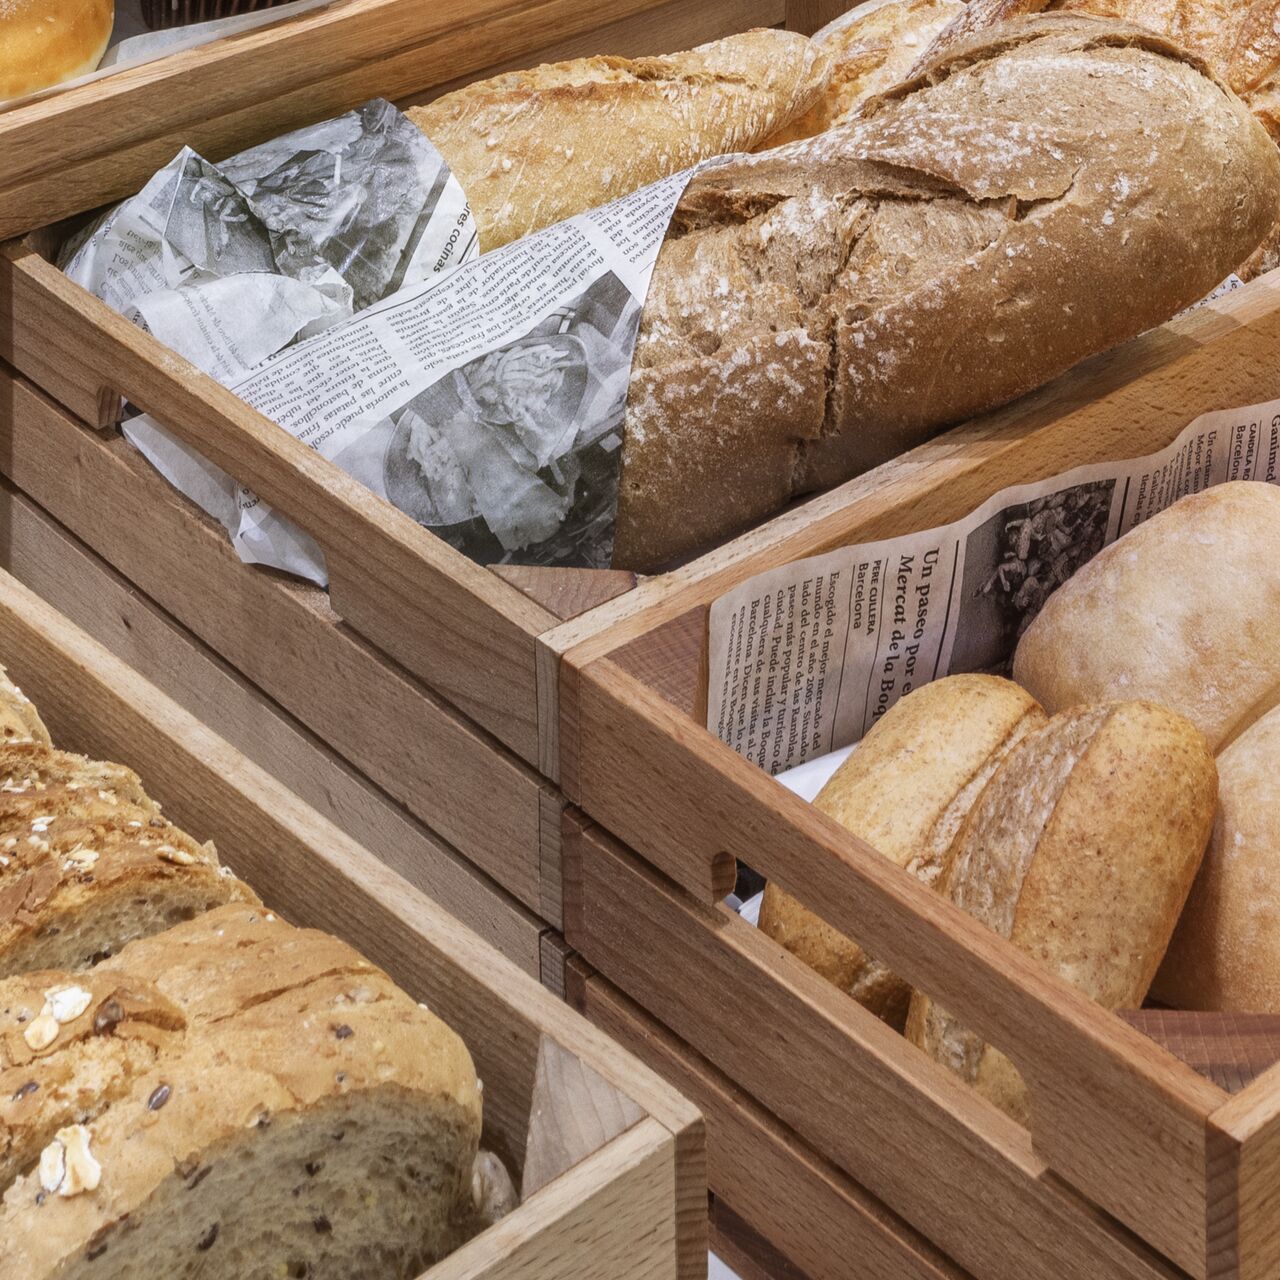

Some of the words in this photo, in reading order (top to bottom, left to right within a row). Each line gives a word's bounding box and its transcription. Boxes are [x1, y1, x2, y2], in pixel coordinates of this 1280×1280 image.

[433, 228, 460, 273] cocinas
[360, 387, 376, 399] las
[378, 369, 402, 388] entre
[399, 379, 410, 387] la
[323, 395, 357, 422] patatas
[870, 560, 882, 585] PERE
[921, 547, 940, 579] Un
[787, 584, 796, 619] paseo
[801, 579, 813, 606] lado
[814, 576, 824, 620] mundo
[824, 571, 840, 626] Escogido
[853, 562, 869, 629] Barcelona
[894, 554, 915, 625] Mercat
[800, 609, 810, 628] del
[866, 587, 878, 636] CULLERA
[913, 583, 930, 639] paseo
[757, 594, 772, 658] cualquiera
[786, 621, 796, 647] más
[812, 621, 820, 637] en
[824, 628, 834, 639] el
[889, 630, 905, 651] de
[768, 635, 782, 673] Puede
[797, 630, 806, 669] centro
[810, 639, 820, 650] el
[818, 640, 830, 675] mejor
[905, 642, 920, 676] por
[755, 659, 765, 674] de
[780, 649, 792, 696] popular
[807, 652, 817, 674] año
[883, 656, 900, 674] la
[741, 664, 753, 702] Dicen
[753, 676, 761, 696] sus
[795, 672, 804, 687] de
[763, 675, 777, 720] incluir
[793, 688, 803, 705] las
[813, 677, 824, 729] mercado
[749, 698, 760, 736] visitas
[762, 718, 771, 729] la
[800, 711, 811, 757] Situado
[812, 732, 821, 751] del
